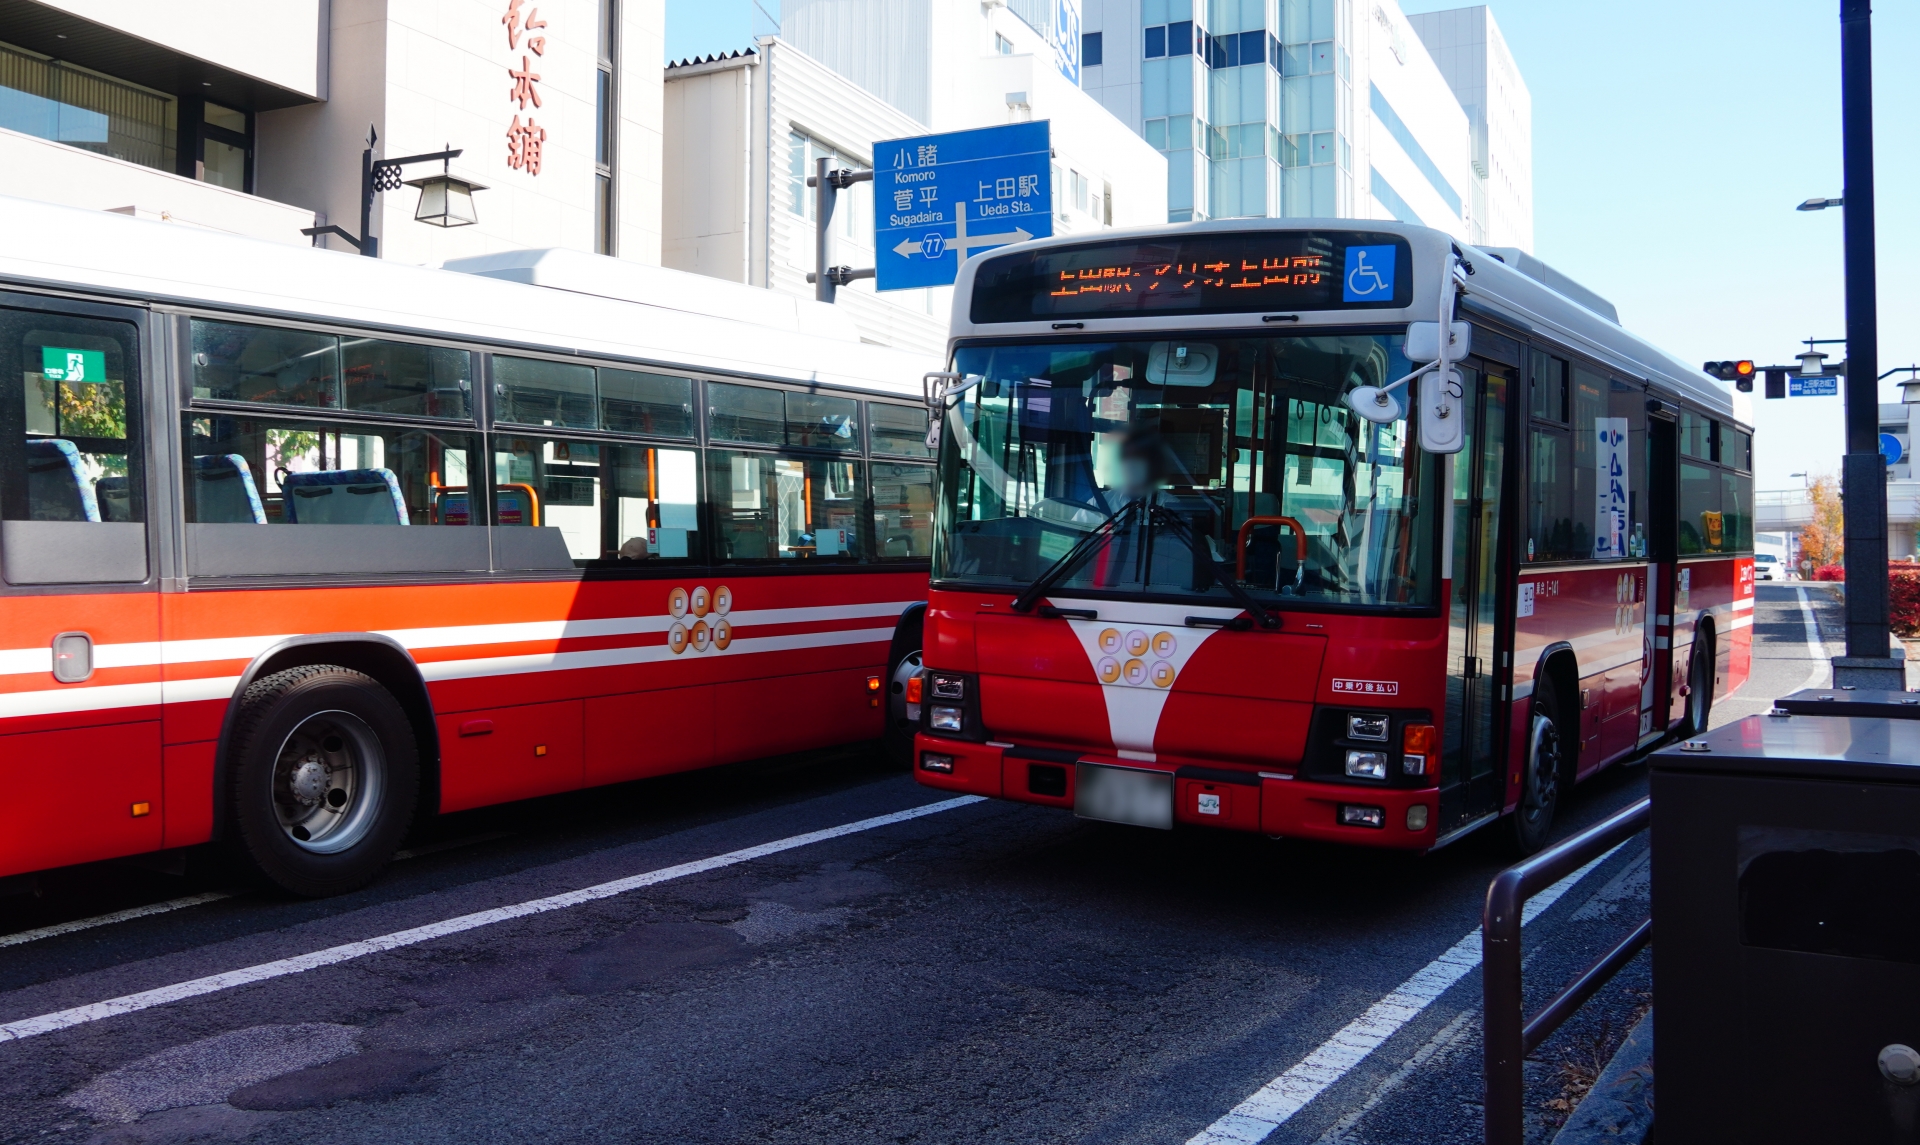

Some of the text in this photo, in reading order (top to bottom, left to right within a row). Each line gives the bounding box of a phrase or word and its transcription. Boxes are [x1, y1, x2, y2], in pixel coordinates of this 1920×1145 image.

[893, 143, 938, 170] 小諸
[895, 170, 936, 184] Komoro
[973, 174, 1040, 203] 上田駅
[893, 186, 939, 212] 菅平
[980, 201, 1034, 217] Ueda Sta.
[890, 211, 943, 228] Sugadaira
[925, 238, 941, 253] 77
[1334, 681, 1396, 693] 中乗り後払い
